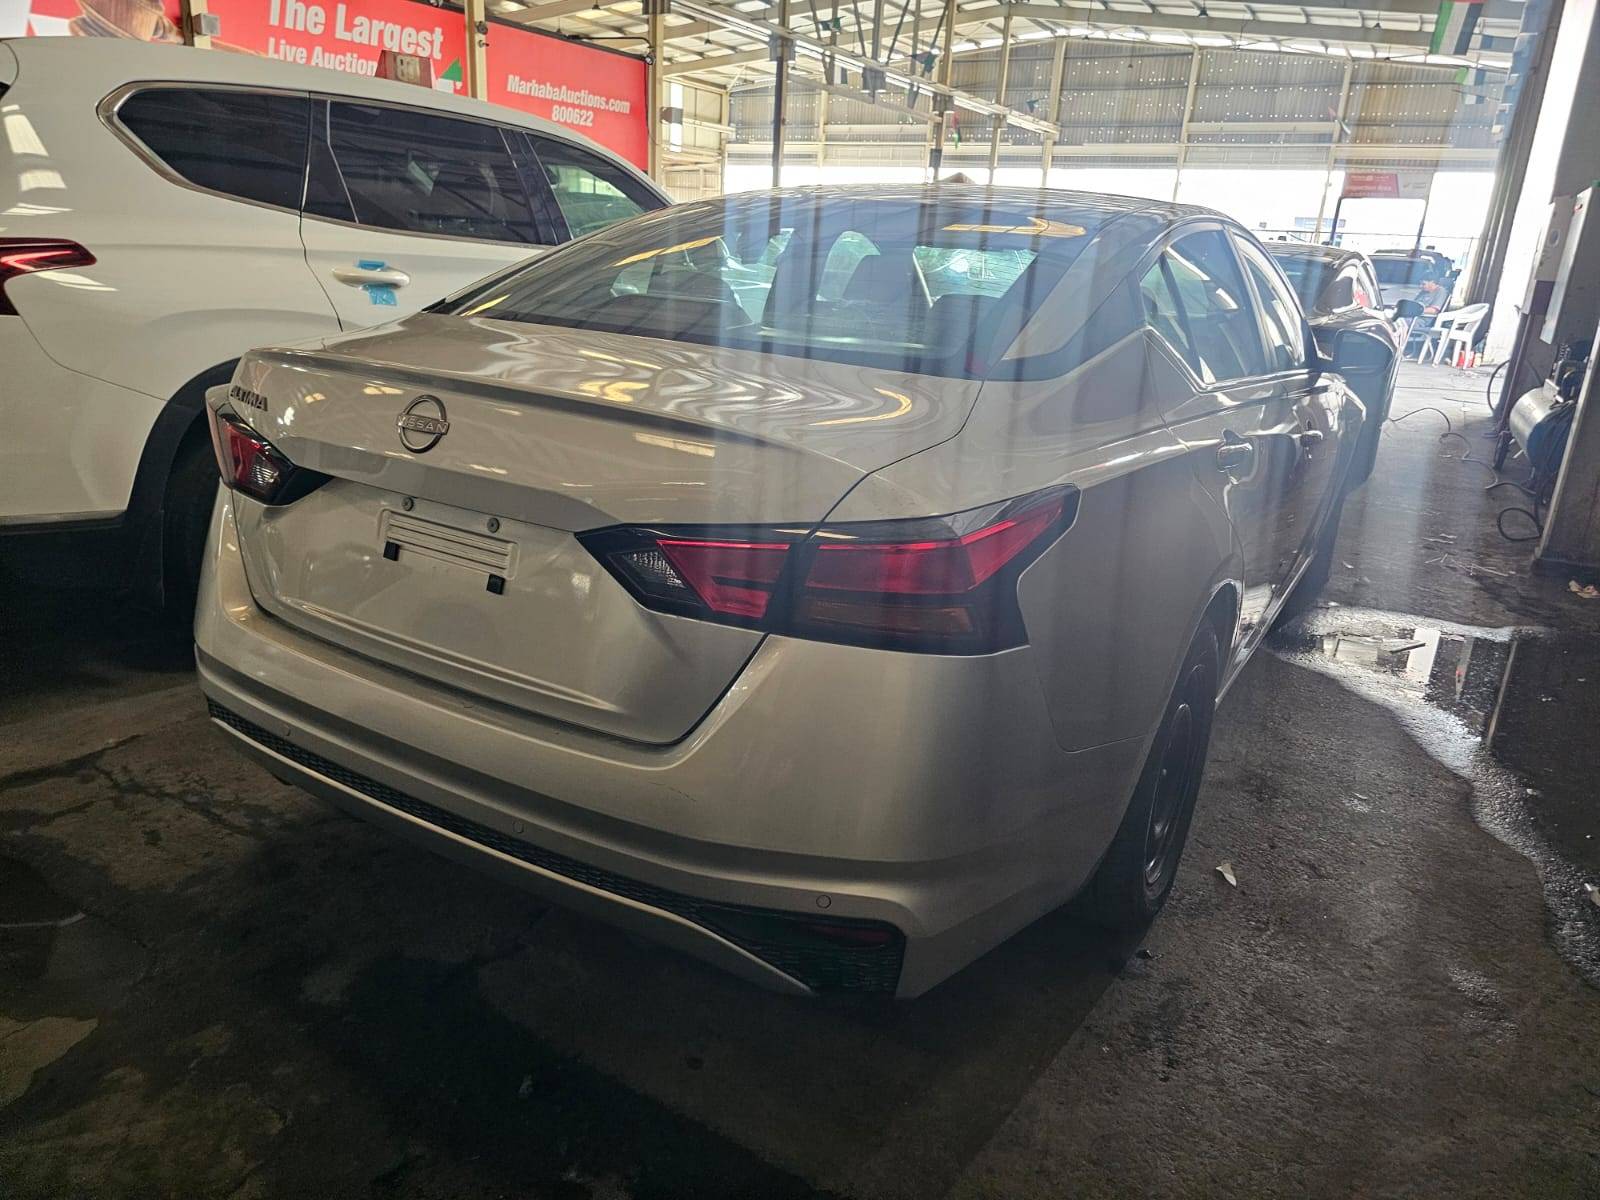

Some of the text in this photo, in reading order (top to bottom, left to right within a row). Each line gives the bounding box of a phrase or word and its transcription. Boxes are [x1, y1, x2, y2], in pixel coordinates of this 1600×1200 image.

[268, 0, 444, 60] The Largest
[267, 36, 308, 65] Live
[507, 74, 631, 114] MarhabaAuctions.com
[551, 105, 594, 127] 800622
[397, 414, 449, 434] NSSAN
